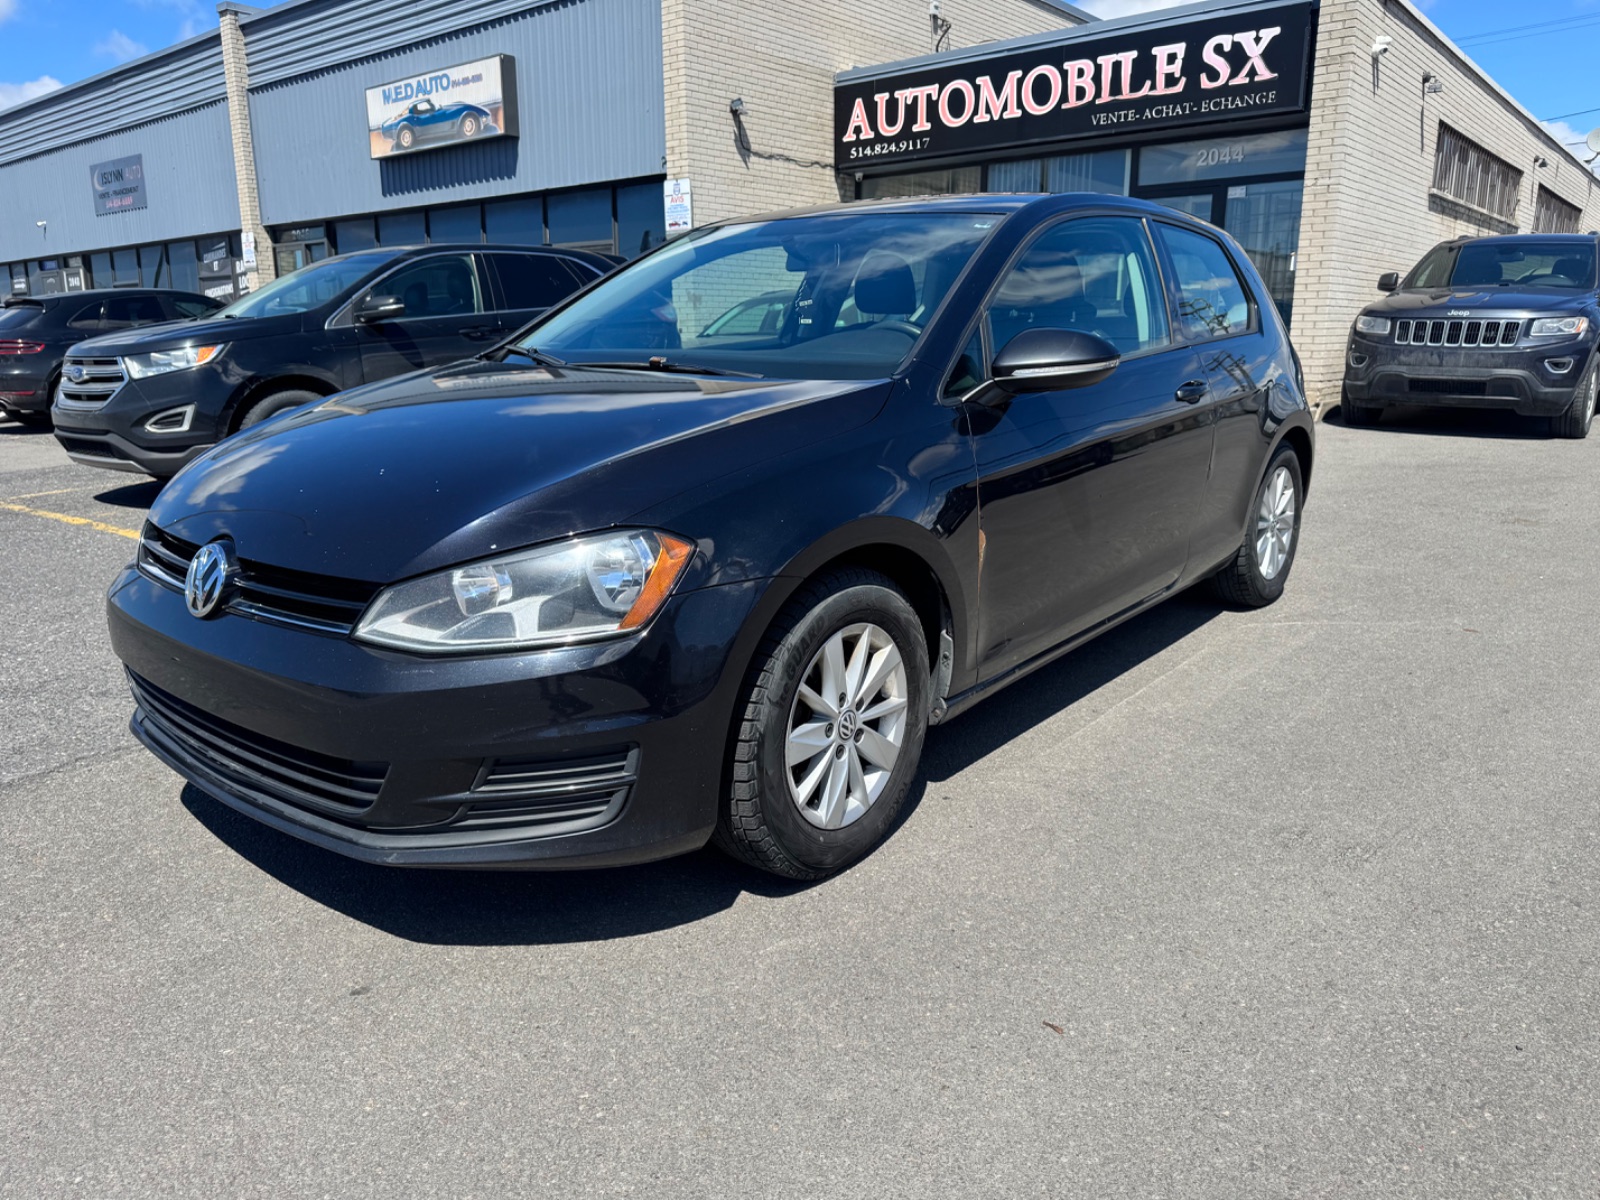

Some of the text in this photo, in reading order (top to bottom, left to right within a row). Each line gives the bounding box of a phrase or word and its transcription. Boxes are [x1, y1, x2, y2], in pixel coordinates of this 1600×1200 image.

[414, 73, 451, 98] AUTO
[842, 26, 1282, 142] AUTOMOBILE SX
[1201, 91, 1277, 113] ECHANGE
[850, 138, 930, 159] 514.824.9117
[1196, 146, 1245, 167] 2044
[1447, 309, 1470, 317] Jeep
